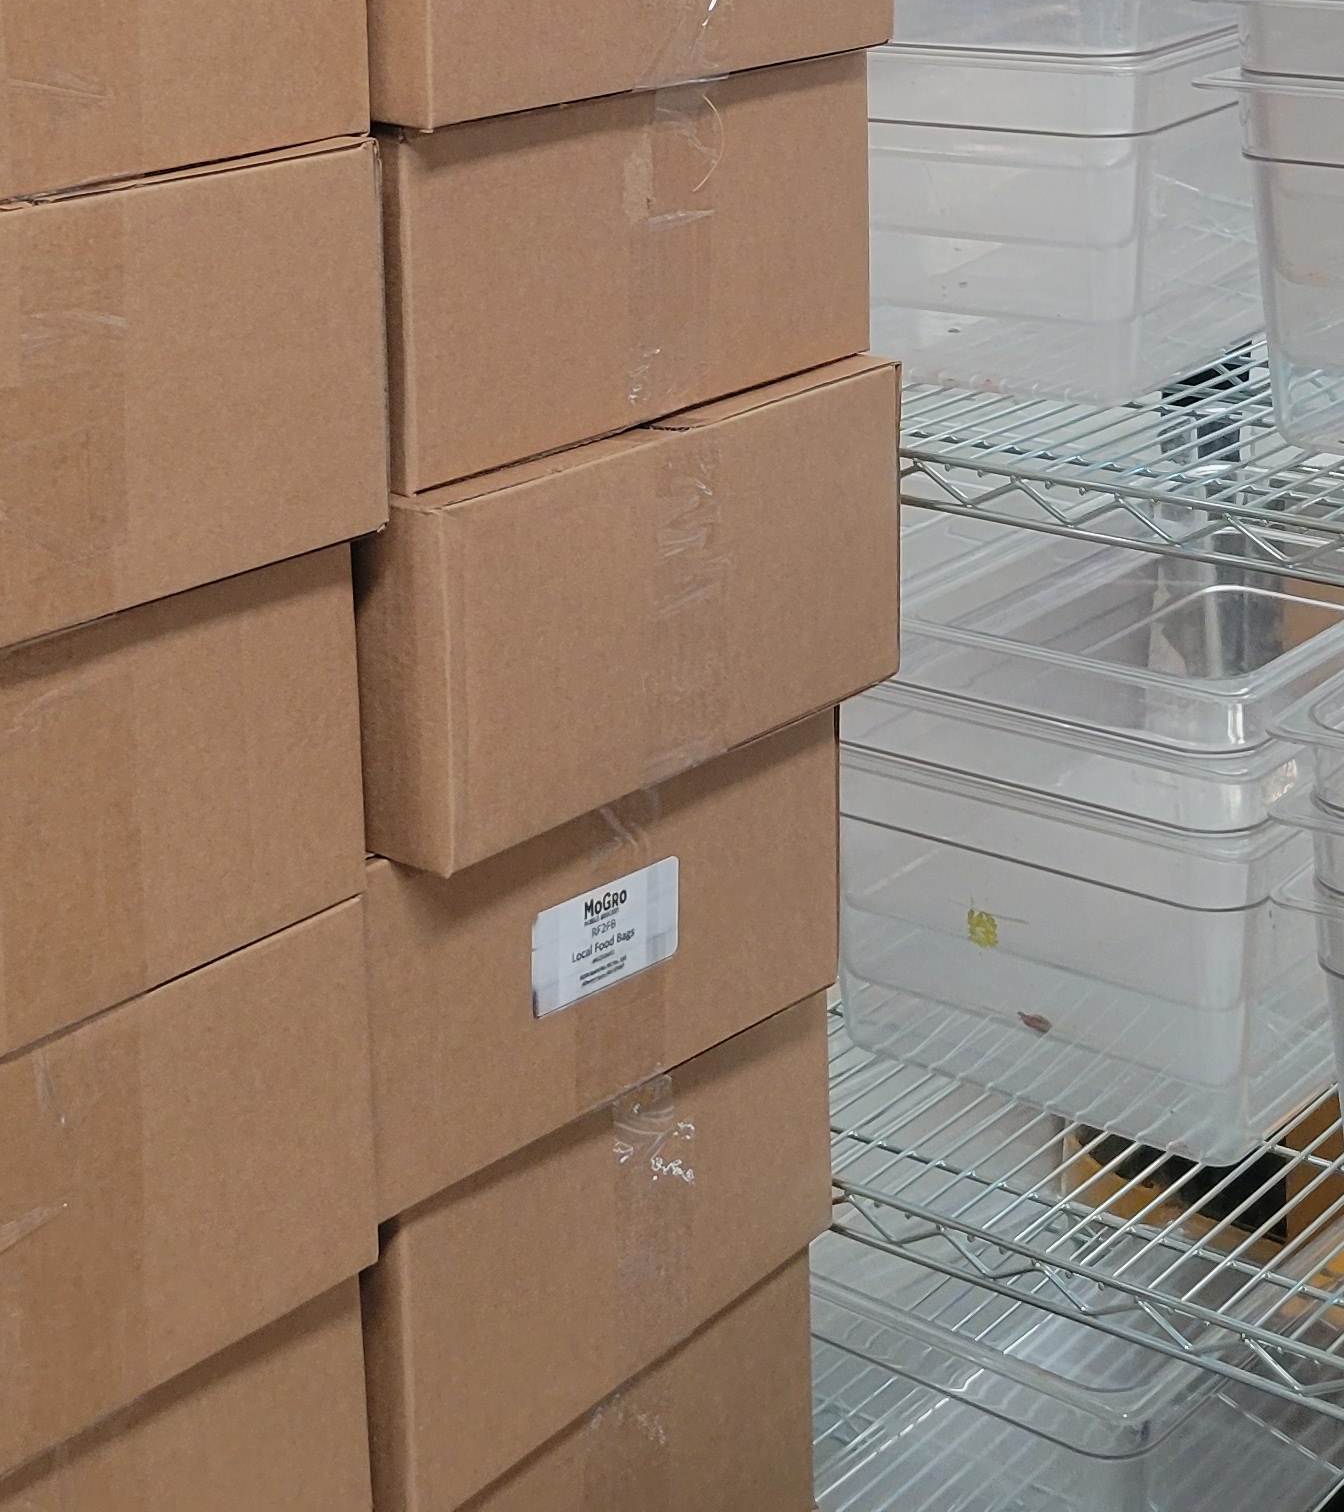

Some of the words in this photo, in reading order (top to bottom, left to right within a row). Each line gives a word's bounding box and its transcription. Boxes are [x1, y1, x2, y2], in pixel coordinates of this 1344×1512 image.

[571, 944, 592, 963] Local
[594, 935, 615, 953] Food
[616, 928, 635, 943] Bags
